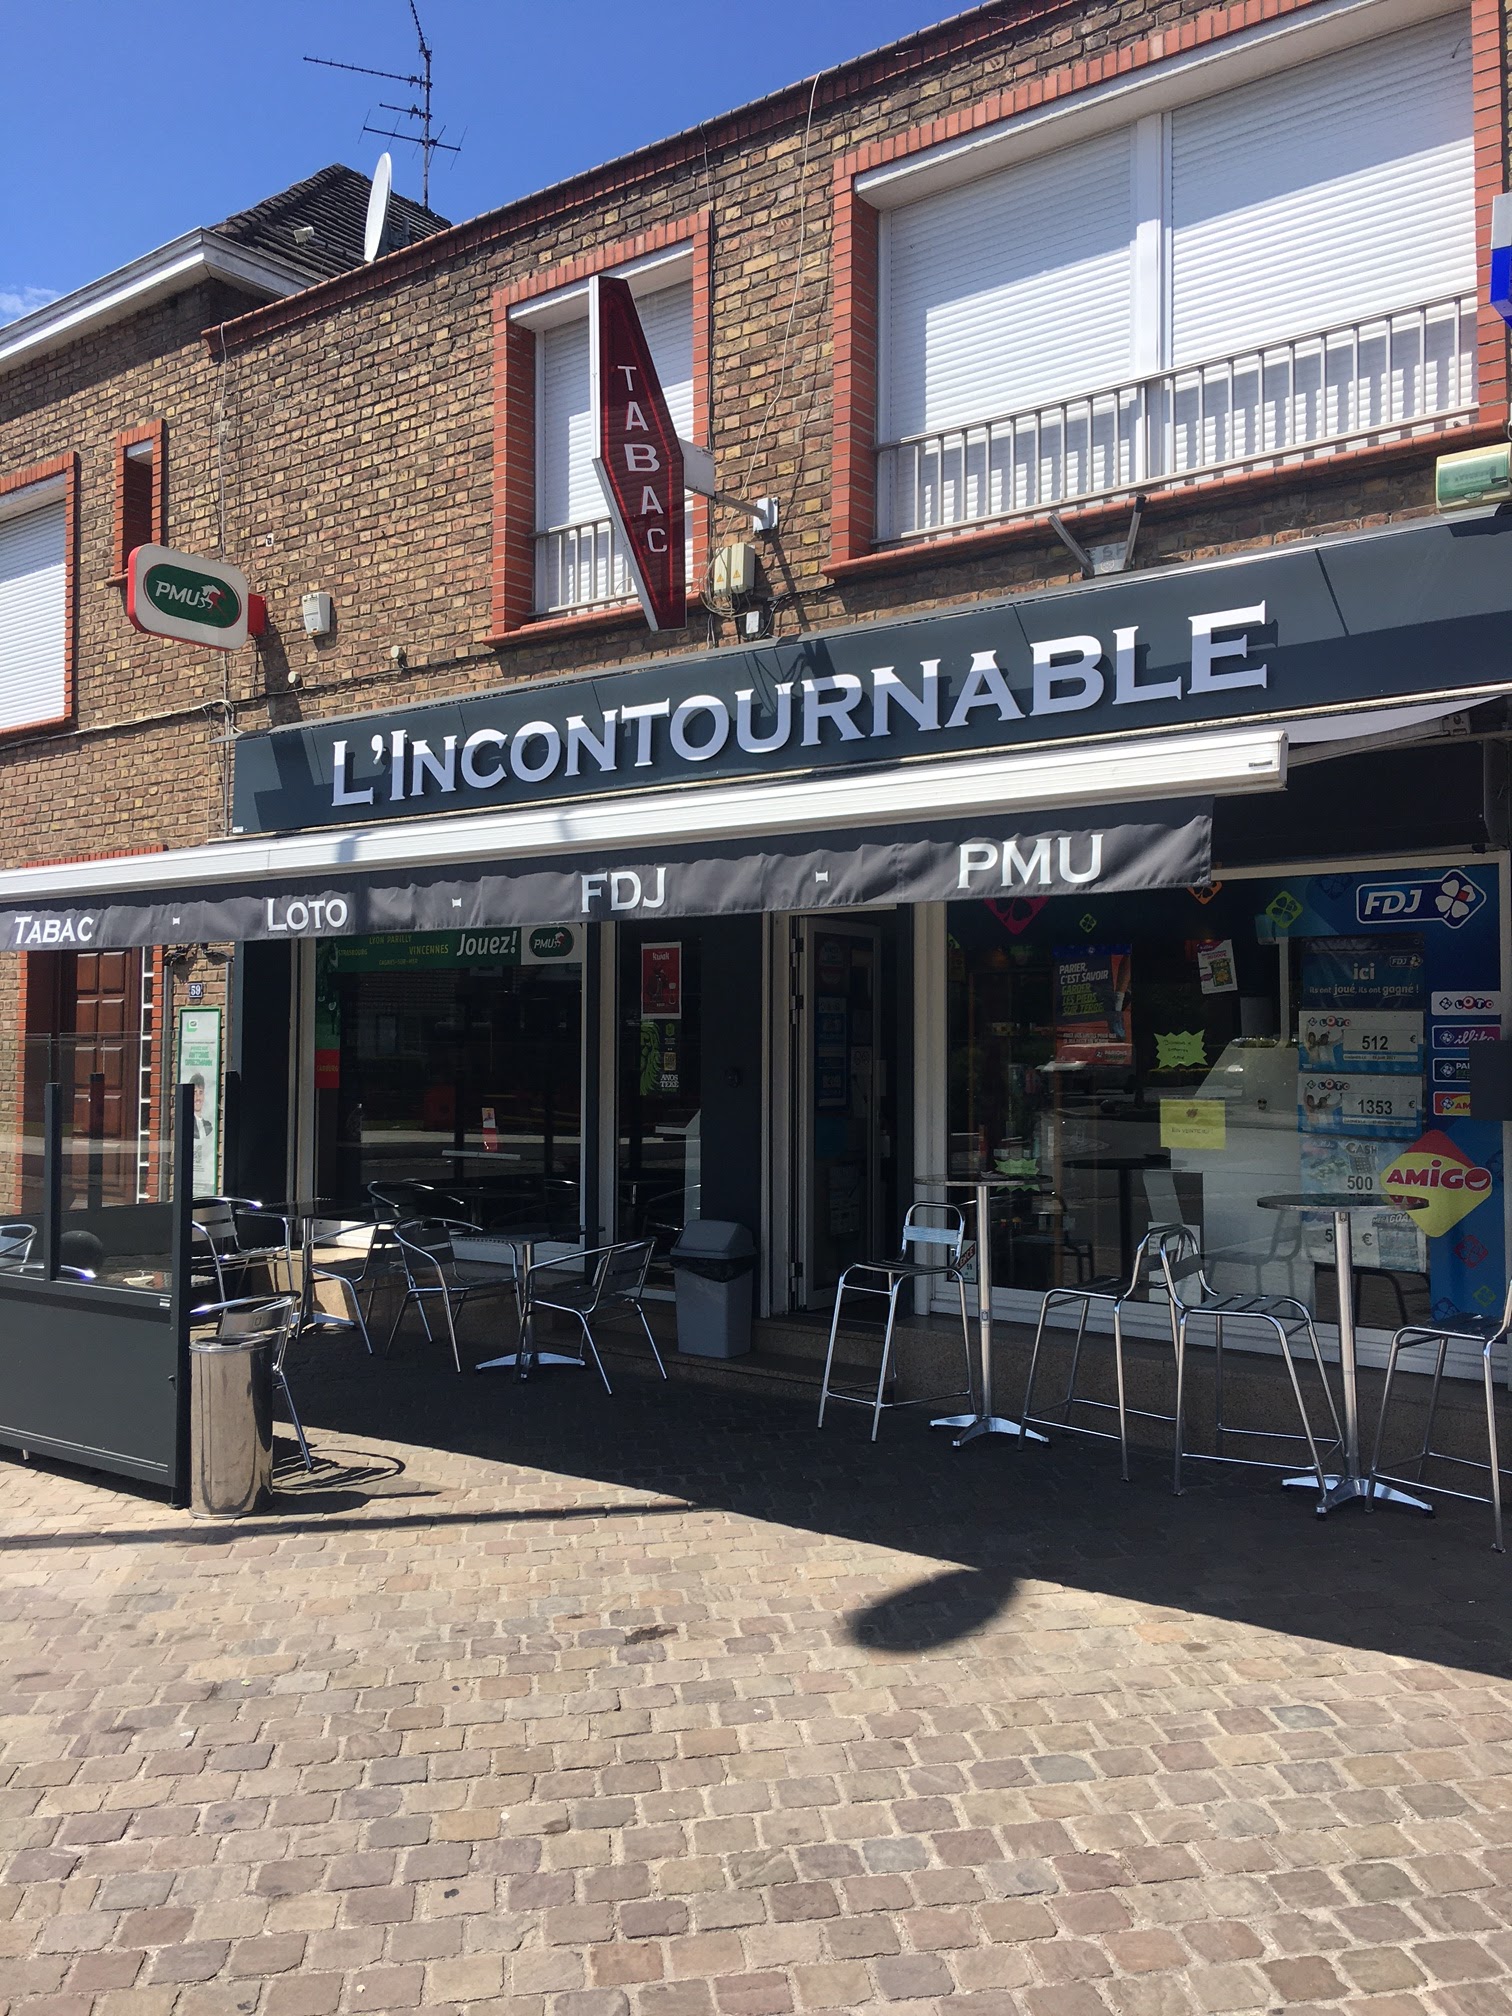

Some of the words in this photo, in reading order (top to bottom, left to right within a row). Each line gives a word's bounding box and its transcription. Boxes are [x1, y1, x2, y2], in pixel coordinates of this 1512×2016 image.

[617, 365, 668, 553] TABAC
[155, 580, 201, 607] PMU
[331, 600, 1267, 806] L'INCONTOURNABLE
[14, 915, 95, 944] TABAC
[267, 897, 348, 932] LOTO
[580, 866, 667, 914] FDJ
[956, 833, 1104, 890] PMU
[1364, 889, 1422, 915] FDJ
[408, 944, 449, 955] VINCENNES
[456, 930, 518, 958] Jouez!
[533, 938, 555, 949] PMU
[1081, 970, 1109, 983] SAVOIR
[1353, 962, 1375, 980] ici
[190, 984, 201, 996] 59
[1309, 986, 1319, 994] ils
[1358, 985, 1368, 993] ils
[1382, 983, 1414, 996] gagné
[1454, 996, 1495, 1010] LOTO
[1361, 1035, 1389, 1051] 512
[1409, 1034, 1417, 1044] €
[1357, 1099, 1393, 1115] 1353
[1408, 1100, 1416, 1109] €
[1345, 1142, 1378, 1155] CASH
[1347, 1175, 1373, 1191] 500
